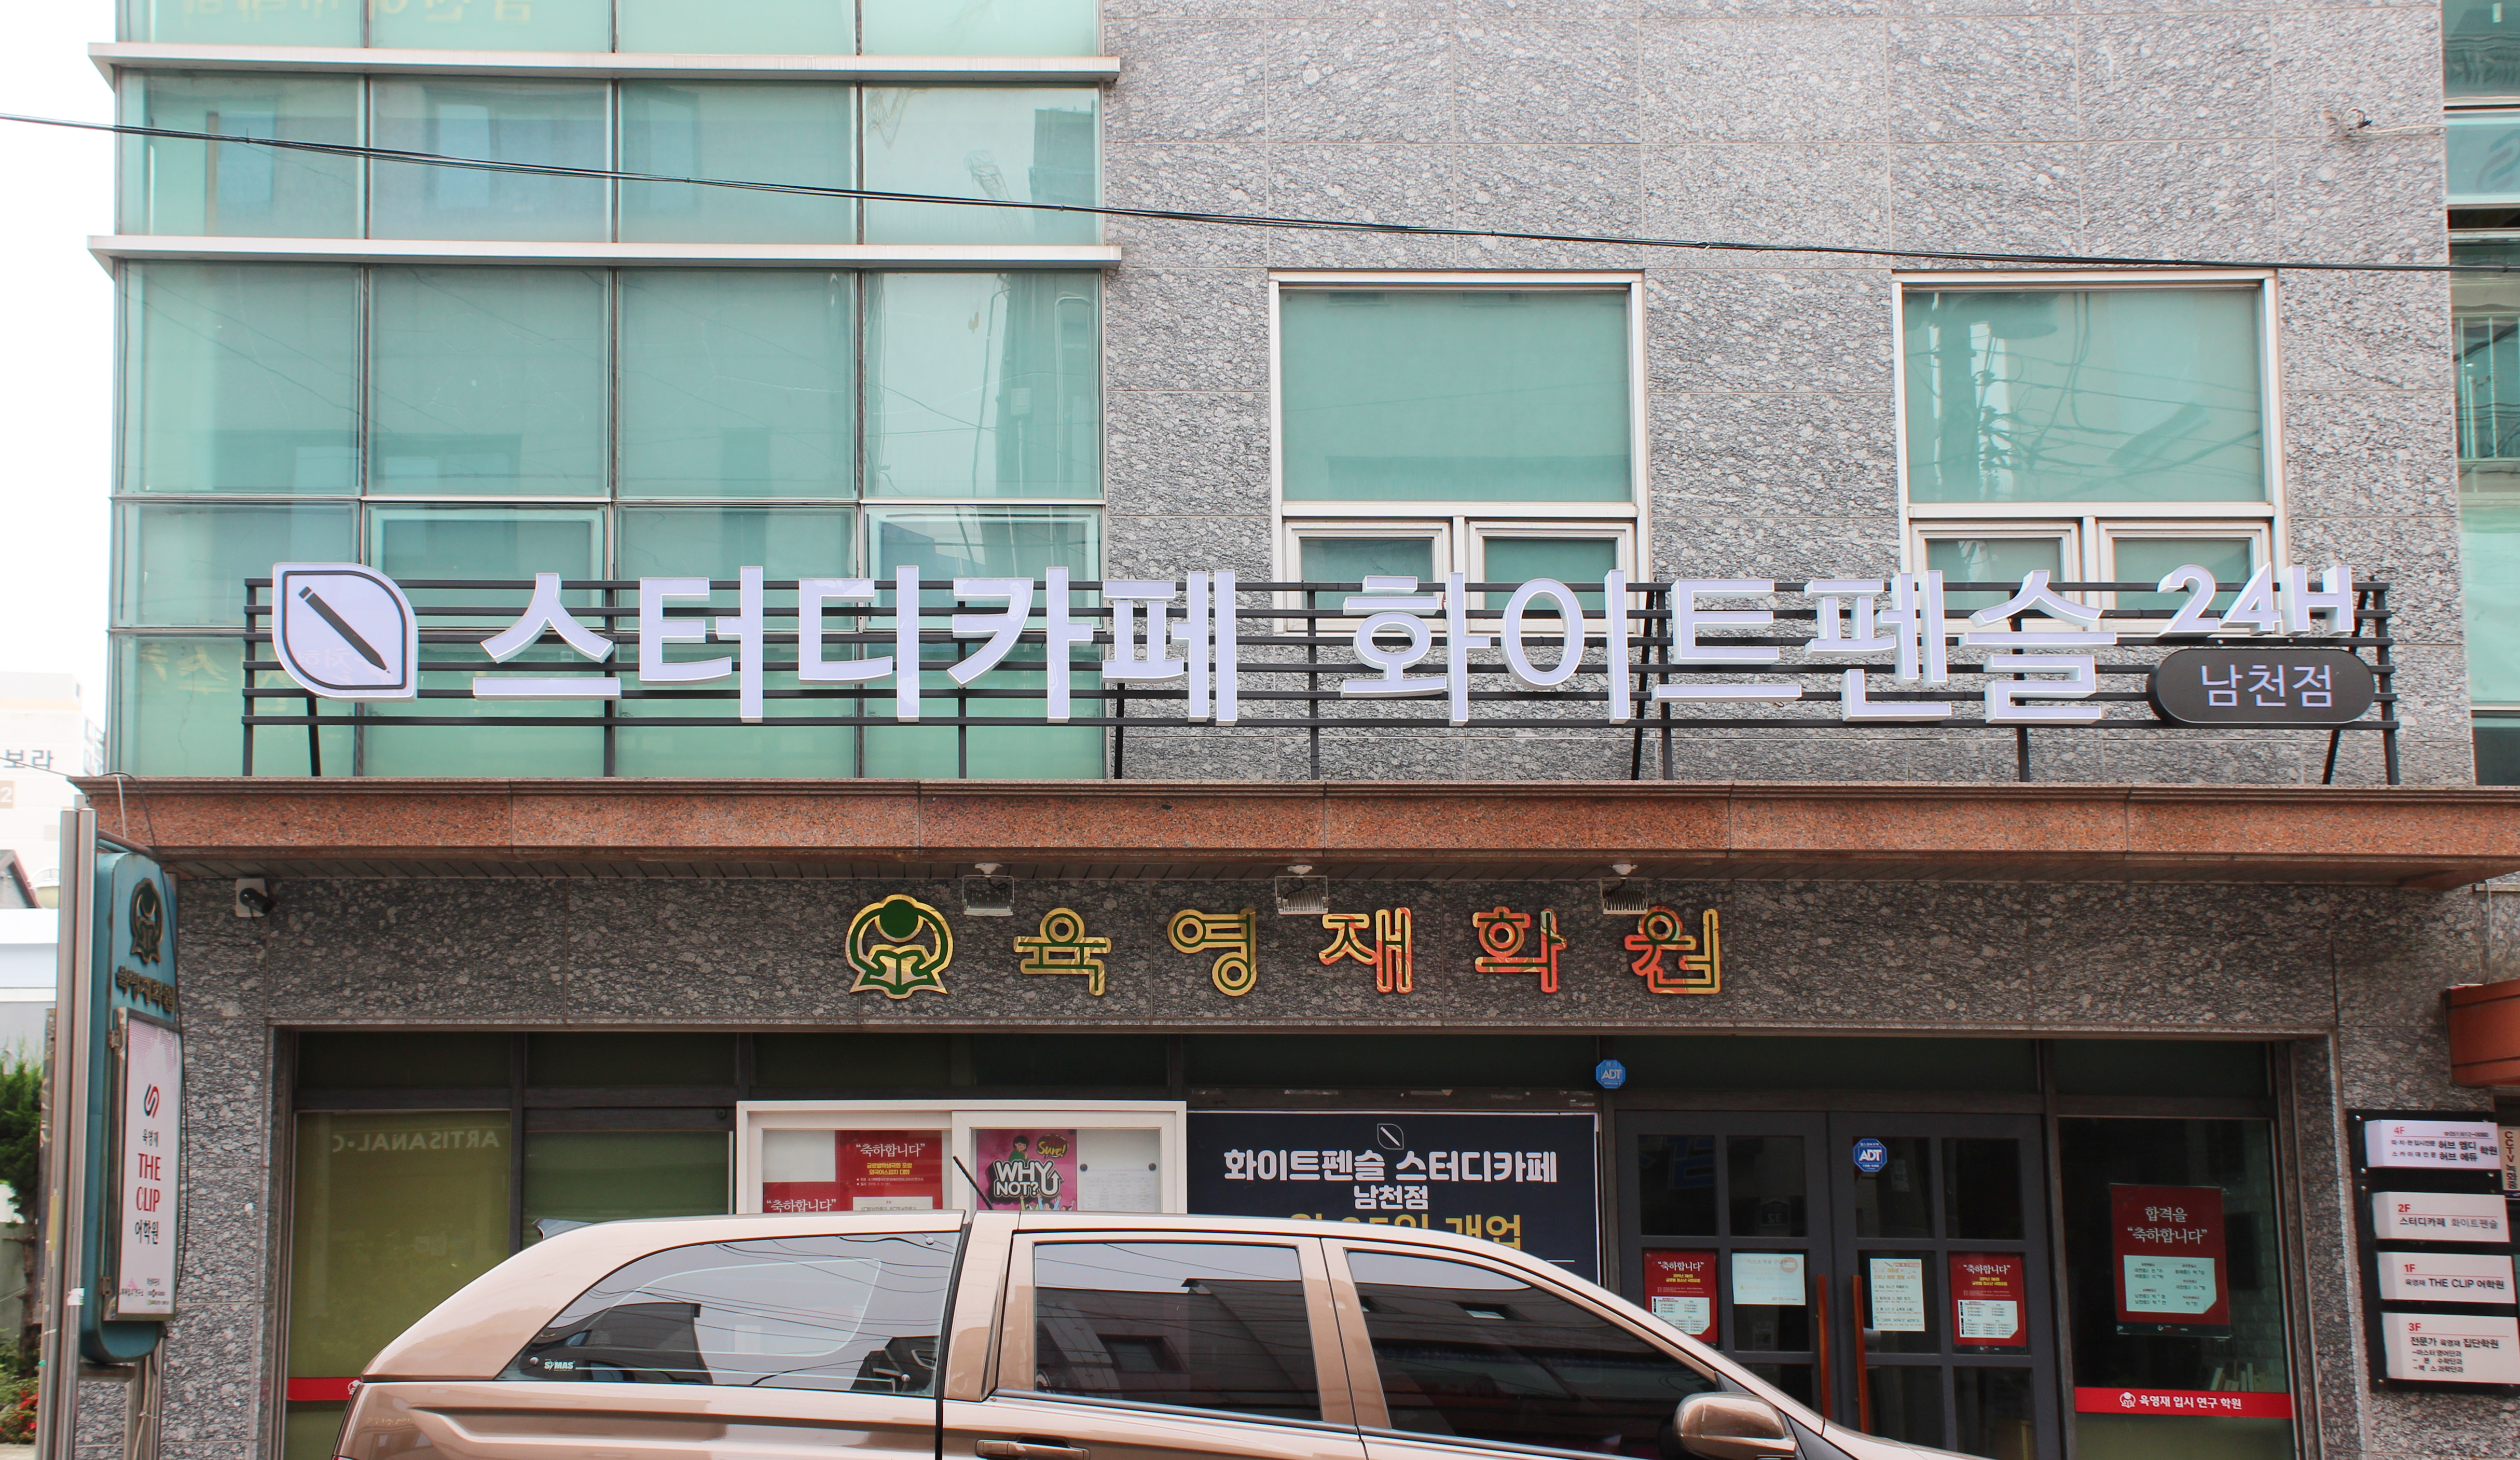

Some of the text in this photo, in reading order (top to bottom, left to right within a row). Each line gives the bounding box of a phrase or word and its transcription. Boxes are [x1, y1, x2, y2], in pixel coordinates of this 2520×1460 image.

[473, 565, 1238, 726] 스터디카페
[1340, 569, 2118, 726] 화이트펜슬
[2157, 561, 2353, 638] 24H
[2201, 664, 2334, 708] 남천점
[1601, 1069, 1622, 1080] ADT
[142, 1128, 159, 1147] 육영재
[2393, 1126, 2405, 1135] 4F
[1037, 1141, 1066, 1157] Sure!
[2439, 1140, 2456, 1150] 허브
[2459, 1141, 2476, 1150] 엠디
[2479, 1146, 2498, 1155] 학원
[2504, 1131, 2514, 1162] CCTV
[1859, 1149, 1882, 1162] ADT
[2439, 1151, 2457, 1161] 허브
[2460, 1153, 2477, 1162] 에듀
[138, 1153, 161, 1181] THE
[1223, 1149, 1557, 1183] 화이트펜슬 스터디카페
[996, 1181, 1039, 1195] NOT?
[136, 1186, 160, 1212] CLIP
[1354, 1185, 1429, 1210] 남천점
[2145, 1206, 2188, 1222] 합격을
[2398, 1204, 2411, 1213] 2F
[2399, 1217, 2499, 1229] 스터디카페 화이트펜슬
[134, 1219, 159, 1245] 어학원
[2404, 1264, 2416, 1272] 1F
[2428, 1278, 2449, 1287] THE
[2452, 1279, 2474, 1288] CLIP
[2477, 1279, 2505, 1289] 어학원
[2408, 1323, 2421, 1331] 3F
[2411, 1337, 2437, 1346] 전문가
[2463, 1338, 2500, 1348] 집단학원
[2139, 1395, 2242, 1410] 육영재 입시 연구 학원
